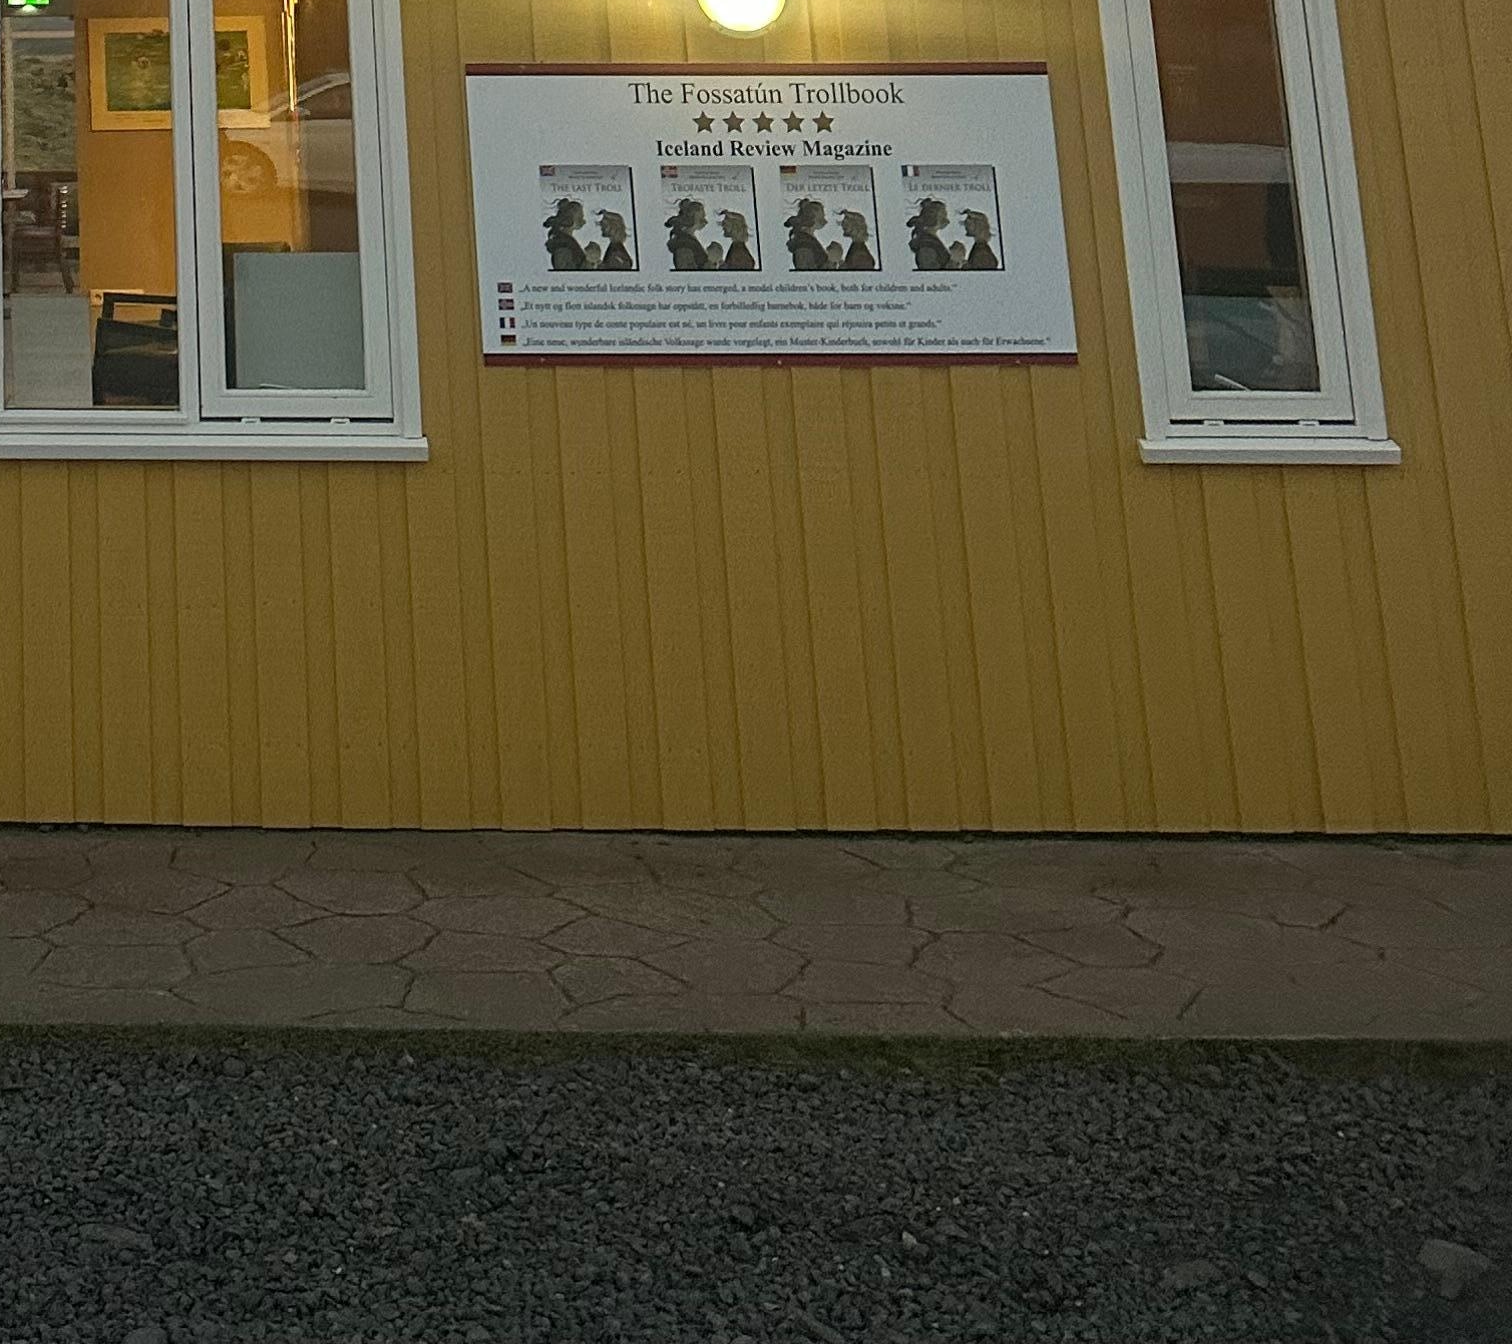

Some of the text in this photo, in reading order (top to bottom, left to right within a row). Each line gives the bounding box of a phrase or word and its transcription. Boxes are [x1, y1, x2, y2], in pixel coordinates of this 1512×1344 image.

[628, 82, 905, 104] The Fossatún Trollbook
[656, 139, 893, 160] Iceland Review Magazine
